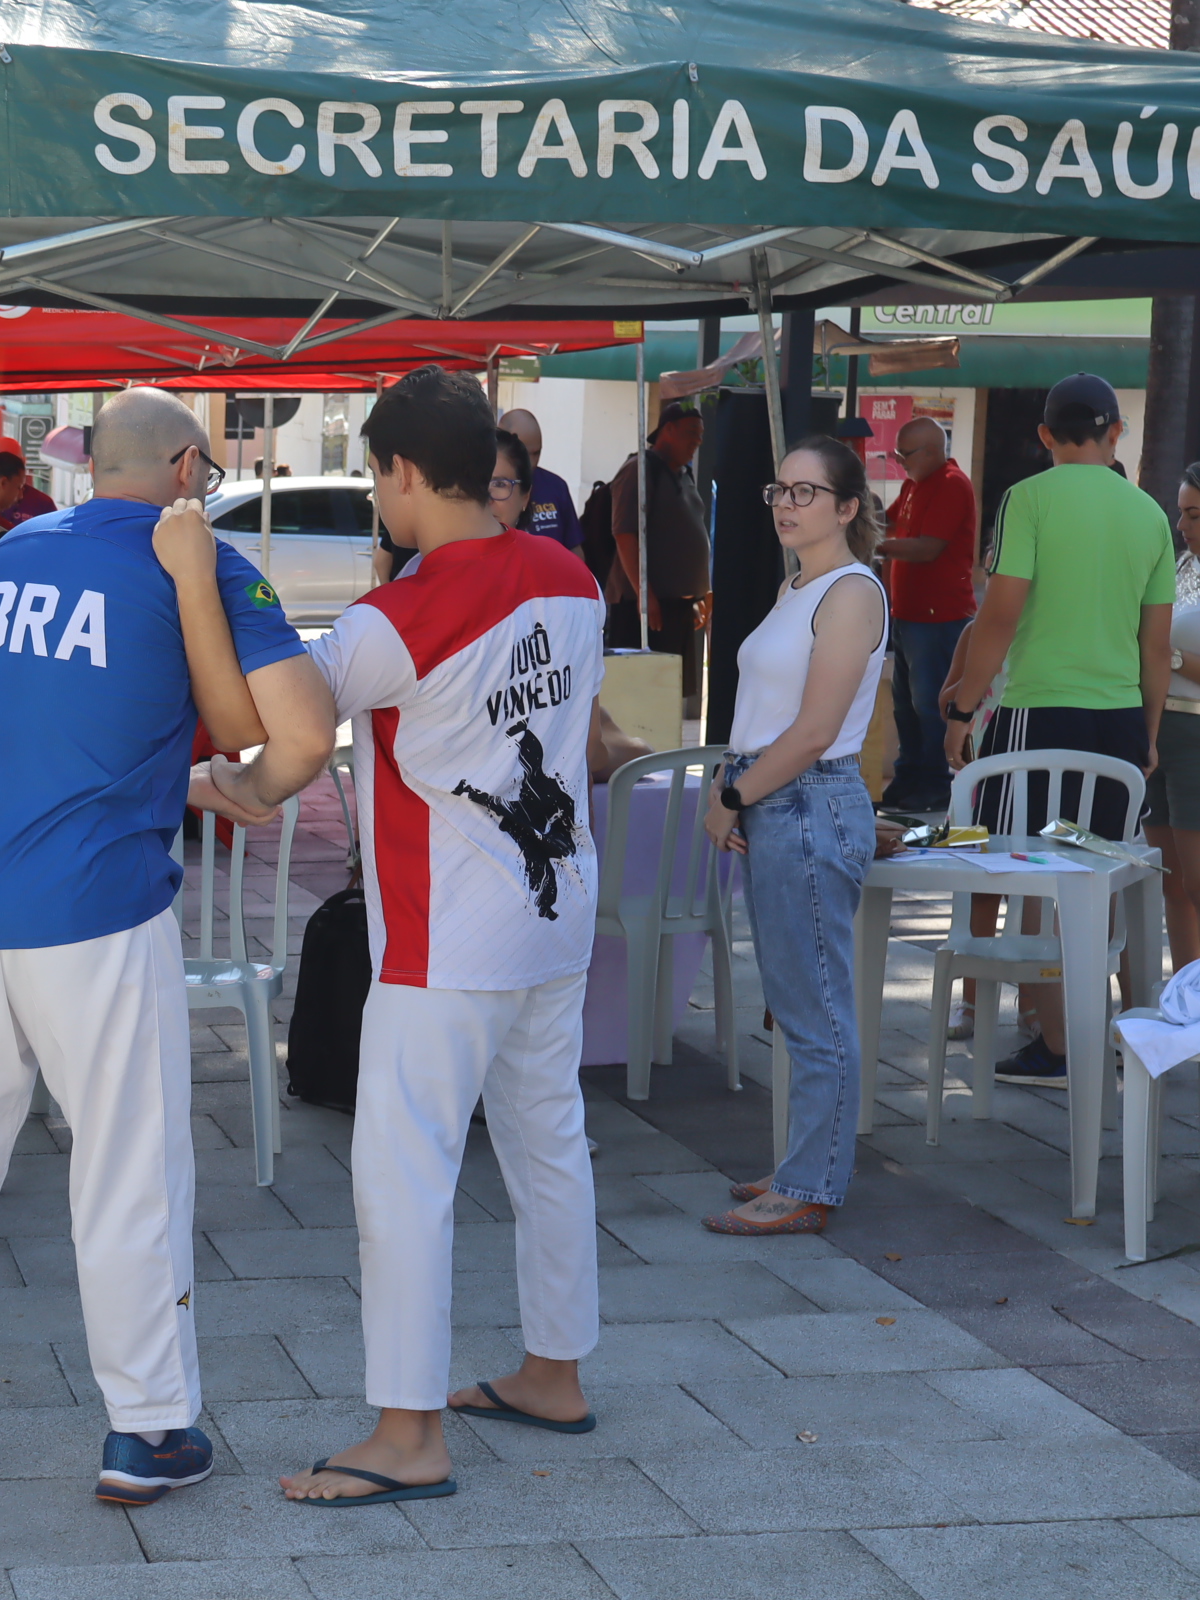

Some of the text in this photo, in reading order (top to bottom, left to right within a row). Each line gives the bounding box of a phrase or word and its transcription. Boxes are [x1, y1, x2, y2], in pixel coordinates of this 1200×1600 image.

[93, 92, 1200, 200] SECRETARIA DA SAÚ
[874, 303, 994, 325] Central
